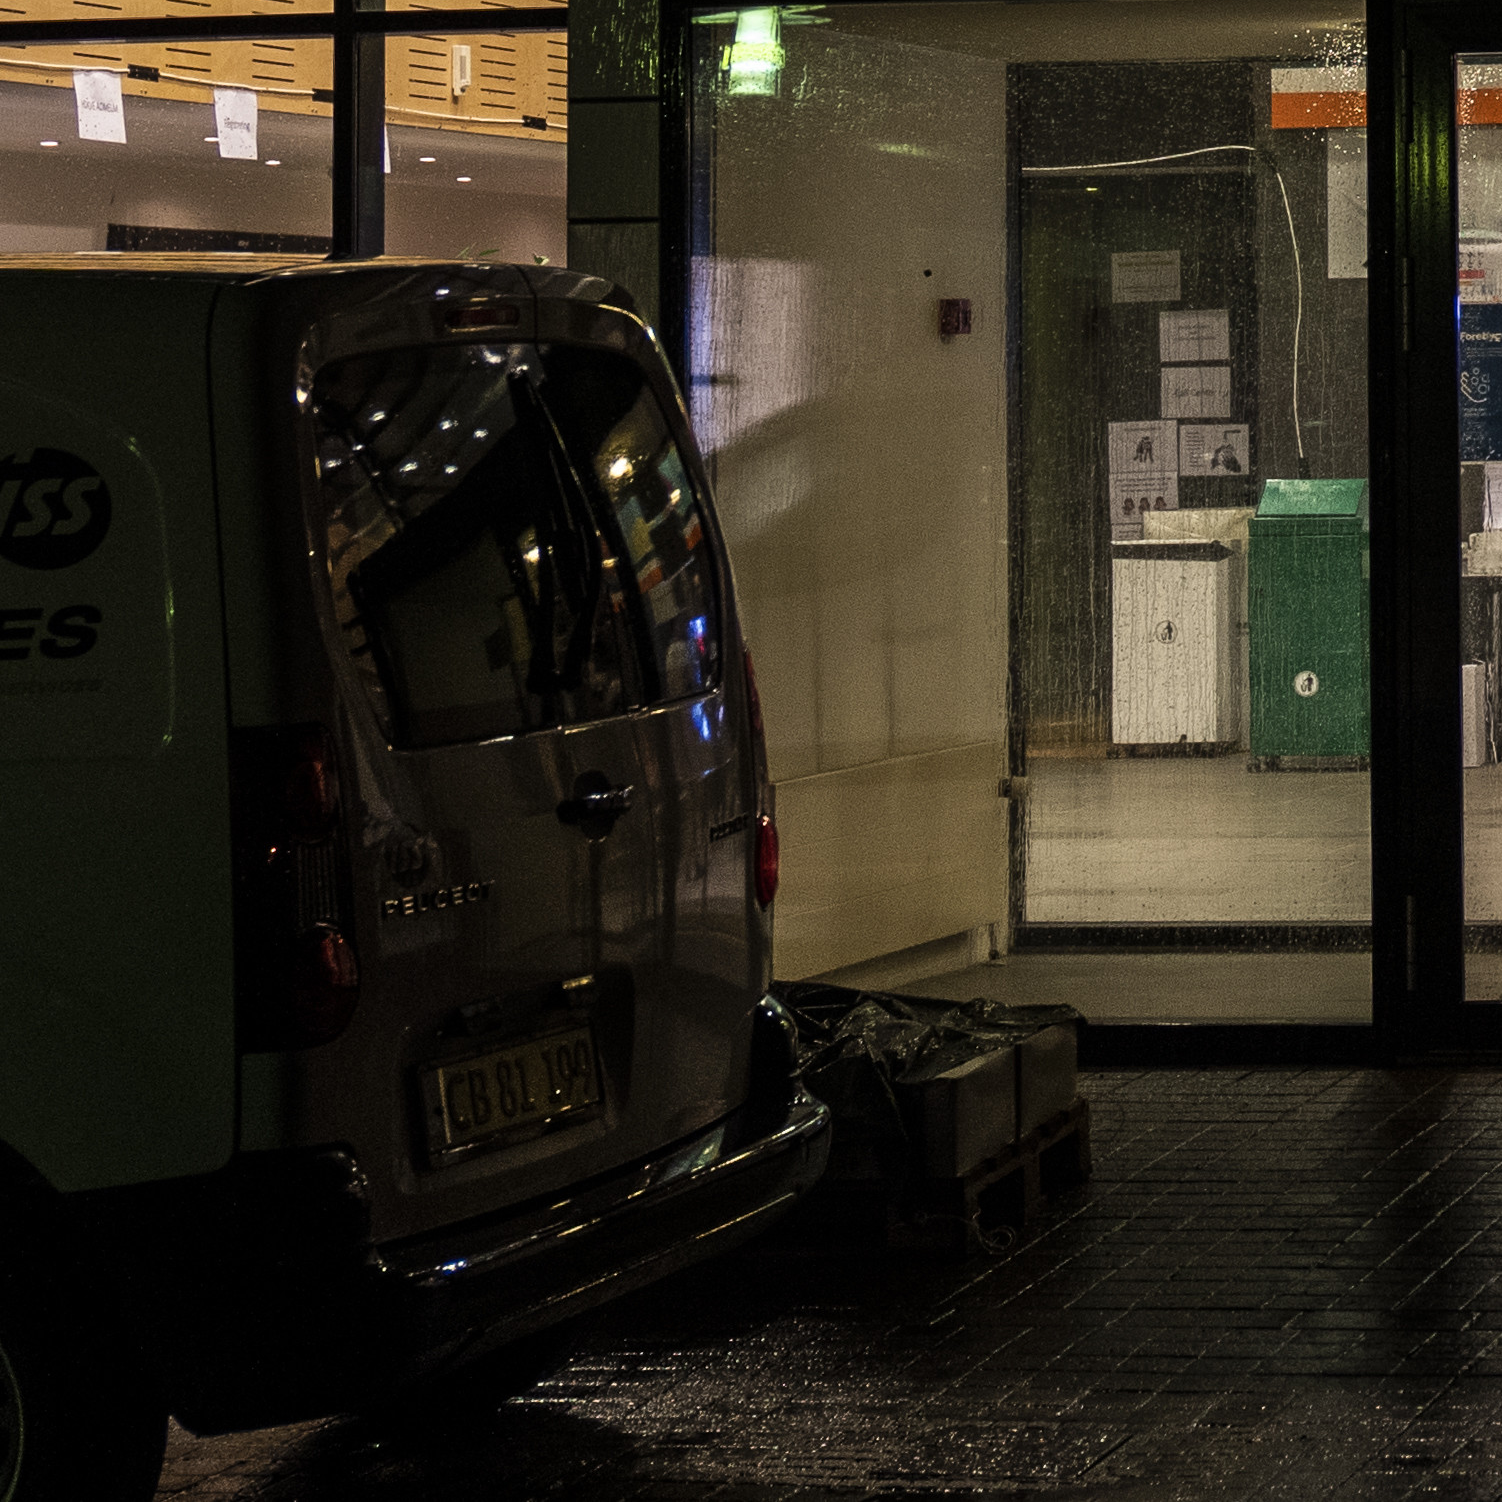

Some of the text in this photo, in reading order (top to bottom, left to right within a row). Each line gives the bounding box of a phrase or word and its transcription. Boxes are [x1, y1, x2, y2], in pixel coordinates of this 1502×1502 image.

[382, 879, 496, 918] PEUGEOT
[446, 1039, 592, 1131] CB 81 199
